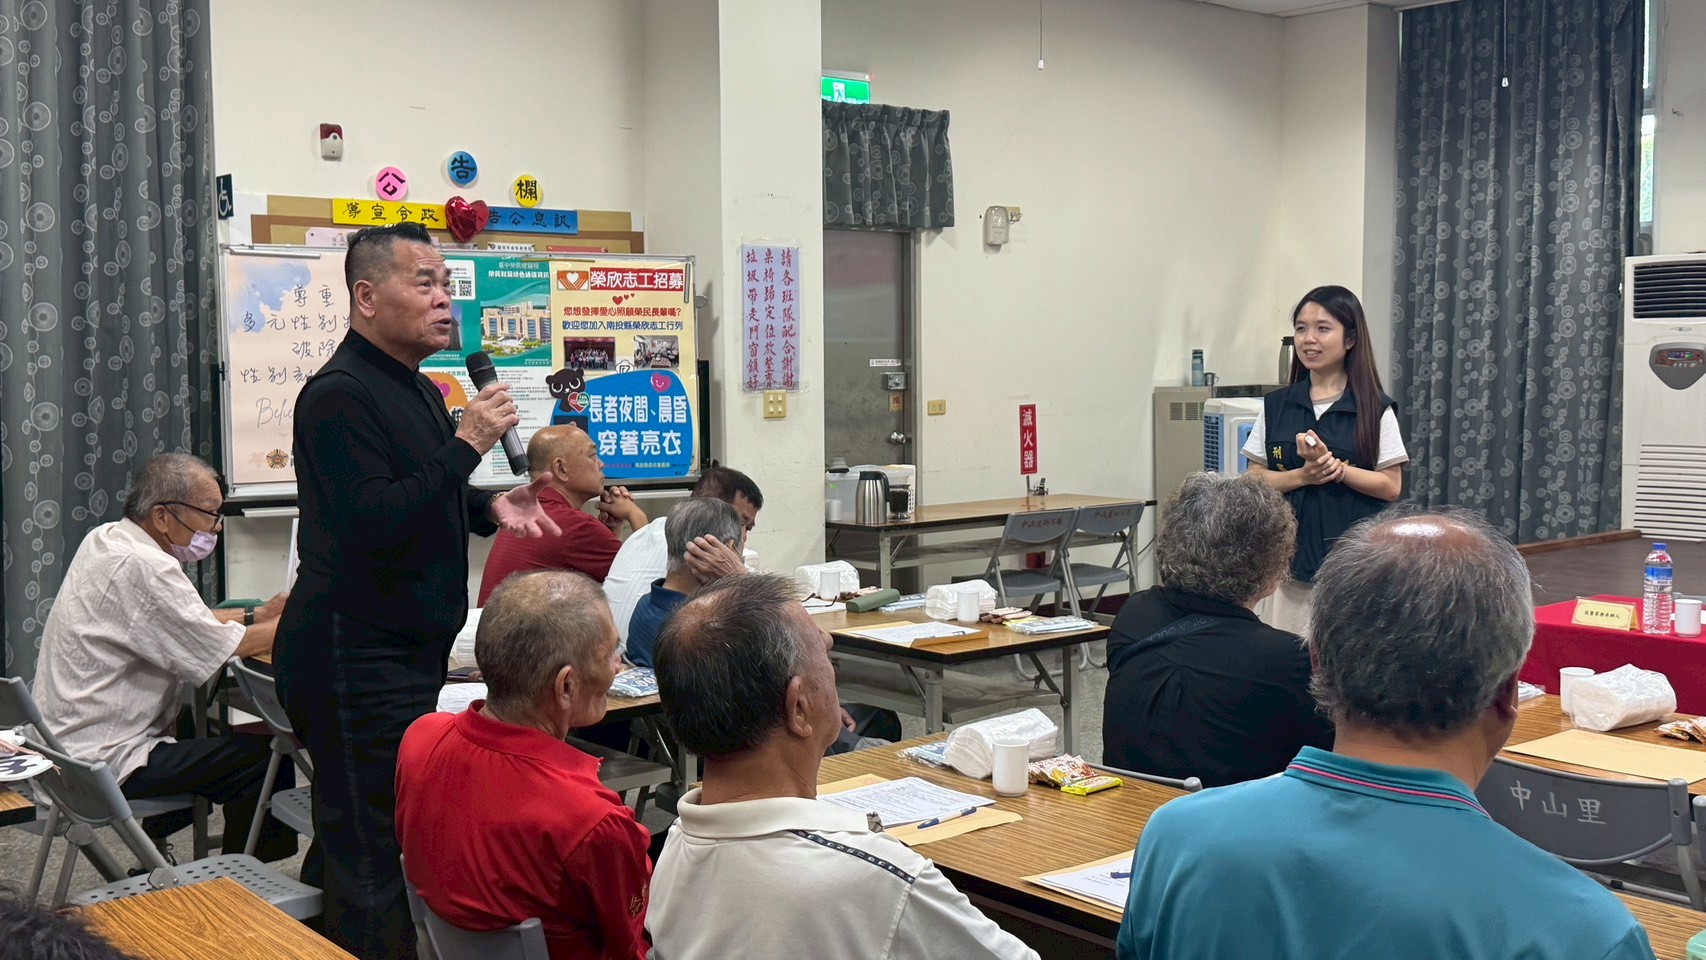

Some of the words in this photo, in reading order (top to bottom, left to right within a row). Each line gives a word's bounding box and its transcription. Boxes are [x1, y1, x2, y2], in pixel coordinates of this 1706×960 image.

[590, 271, 684, 289] 榮欣志工招募
[294, 285, 334, 307] 尊重
[562, 320, 684, 331] 歡迎您加入南投縣榮欣志工行列
[588, 394, 687, 423] 長者夜間、晨昏
[597, 430, 682, 456] 穿著亮衣
[1022, 409, 1034, 469] 滅火器
[1509, 779, 1607, 825] 中山里
